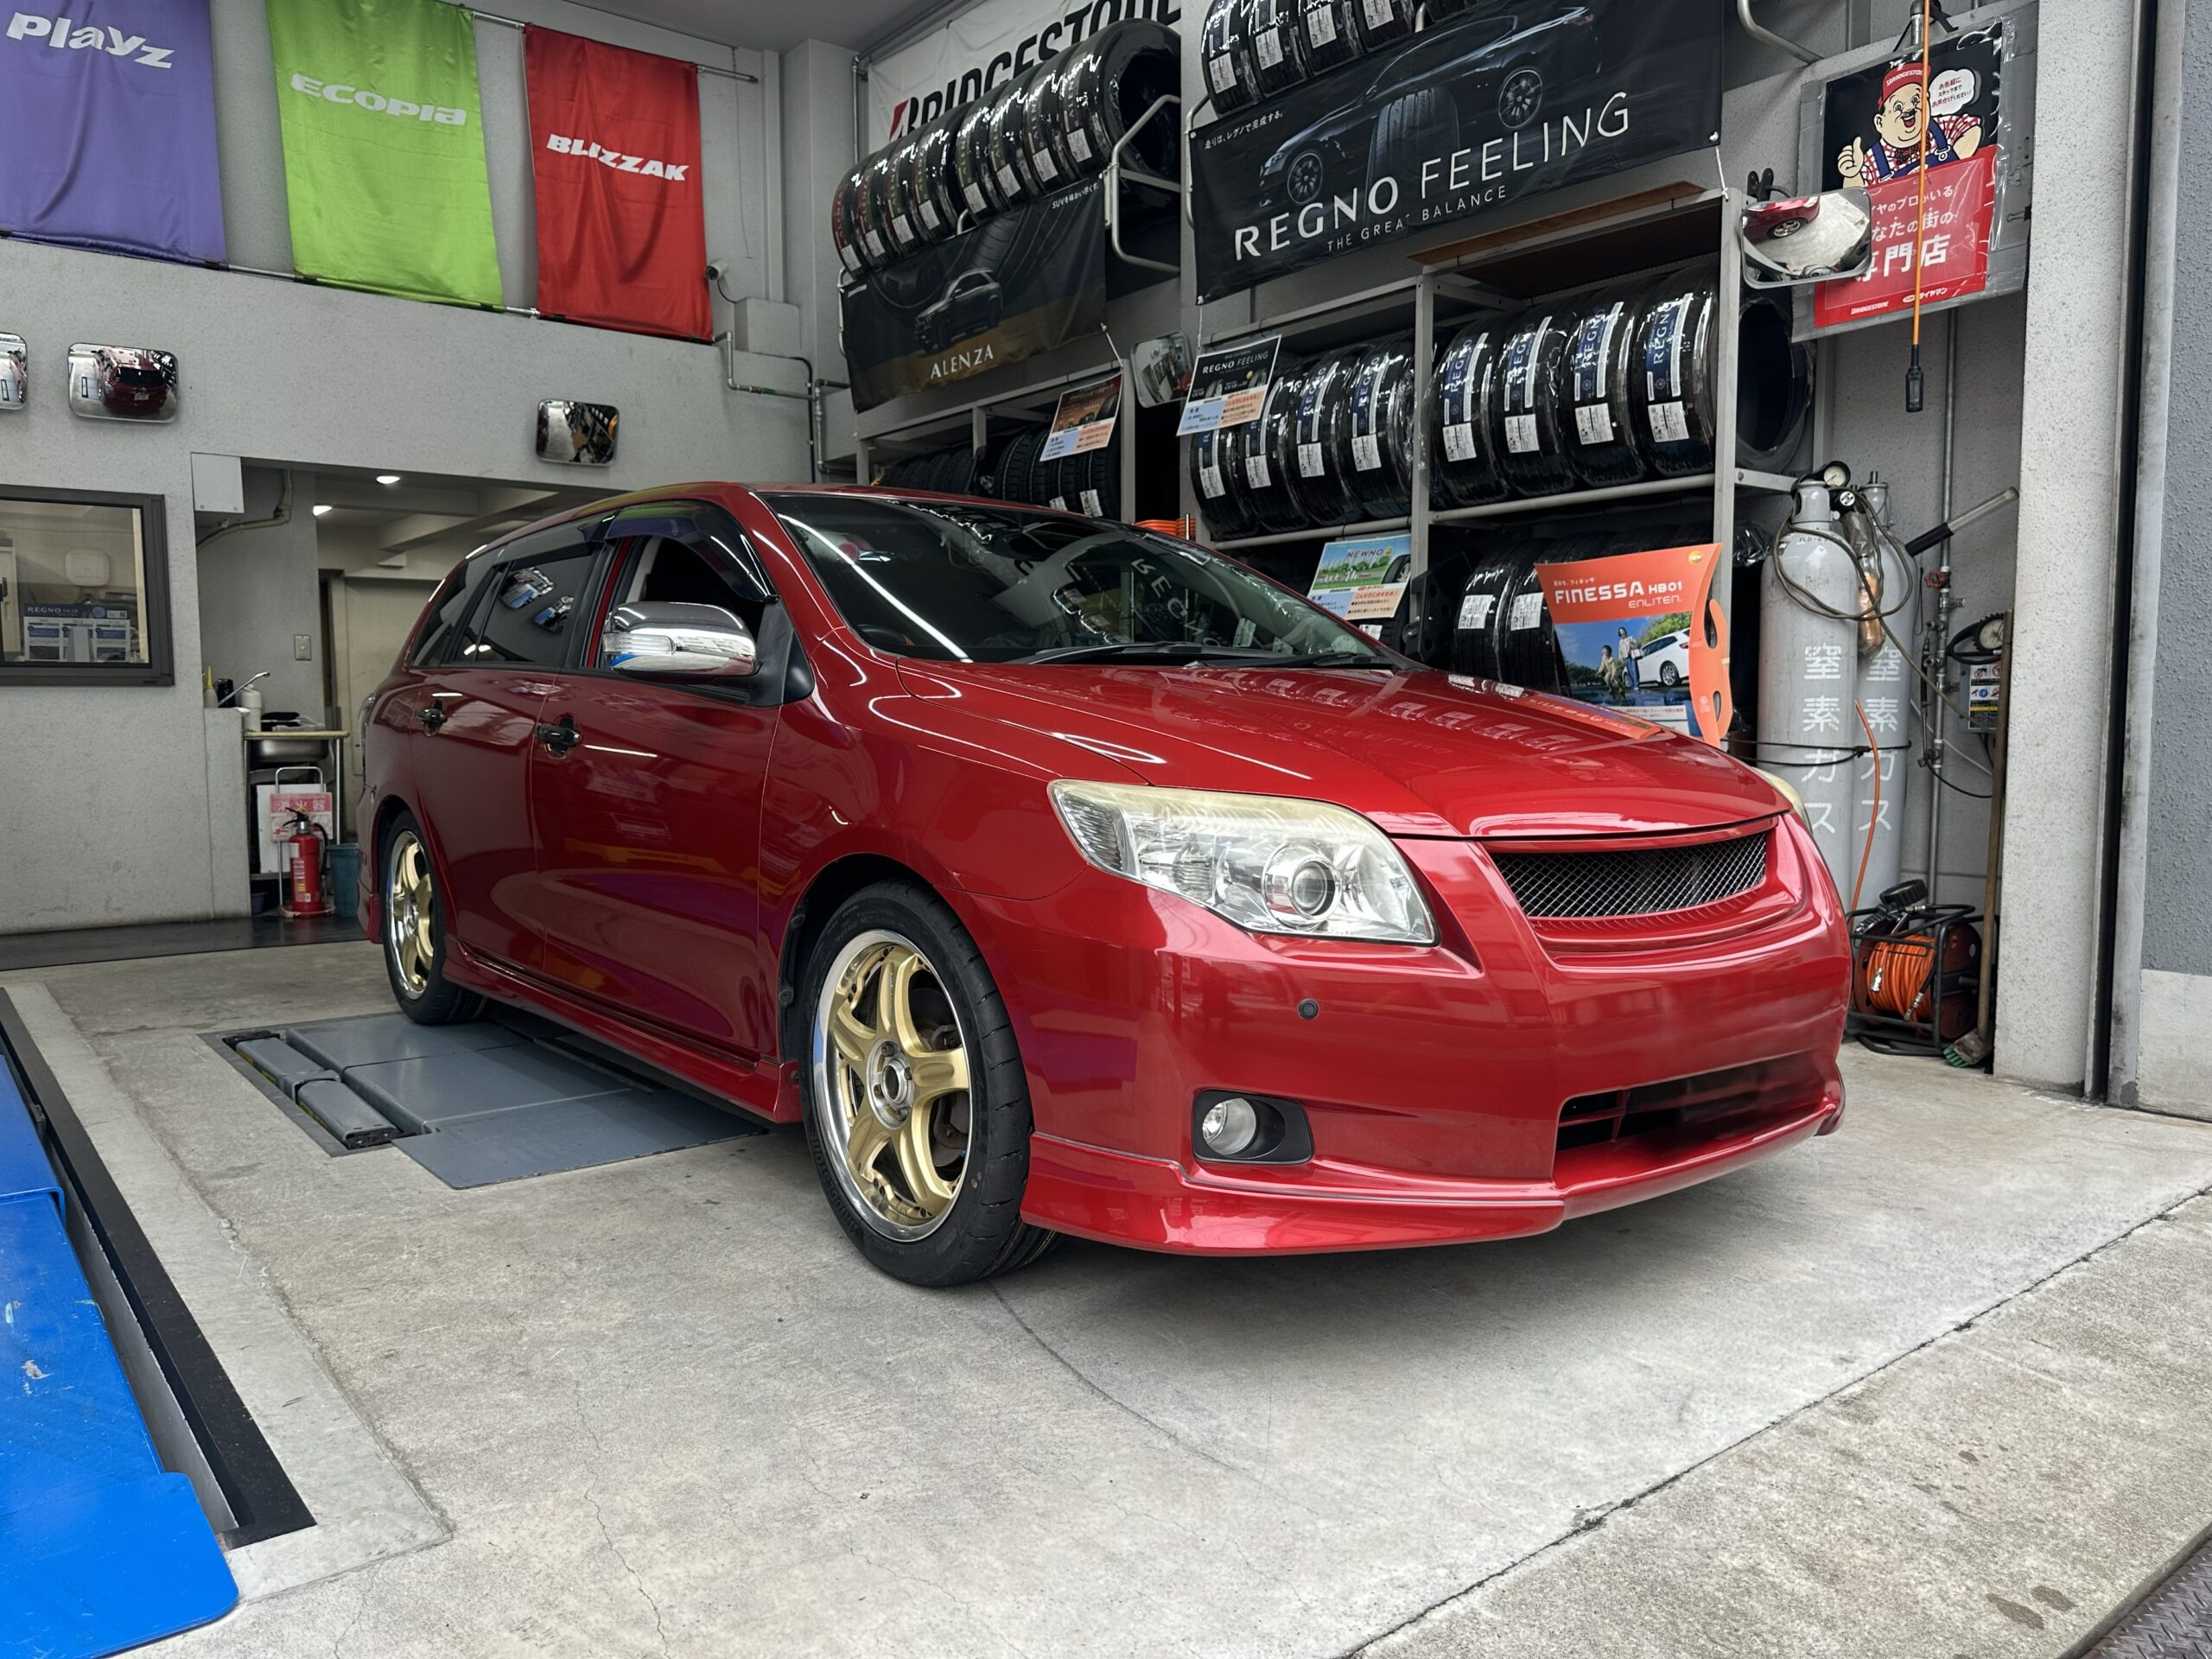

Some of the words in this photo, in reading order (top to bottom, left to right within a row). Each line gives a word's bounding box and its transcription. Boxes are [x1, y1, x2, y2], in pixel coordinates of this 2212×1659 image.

[6, 12, 175, 69] Playz
[546, 133, 690, 181] BLIZZAK
[1234, 176, 1398, 260] REGNO
[1421, 92, 1629, 199] FEELING
[1327, 234, 1352, 252] THE
[1361, 214, 1410, 240] GREA
[1422, 186, 1507, 221] BALANCE
[1851, 302, 1890, 315] BRIDGESTONE
[931, 344, 994, 380] ALENZA
[1202, 360, 1235, 374] REGNO
[1236, 351, 1269, 365] FEELING
[1346, 548, 1384, 558] NEWNO
[1555, 581, 1644, 604] FINESSA
[1649, 581, 1682, 594] HB01
[1802, 643, 1842, 834] 窒素ガス
[1859, 646, 1902, 831] 窒素ガス
